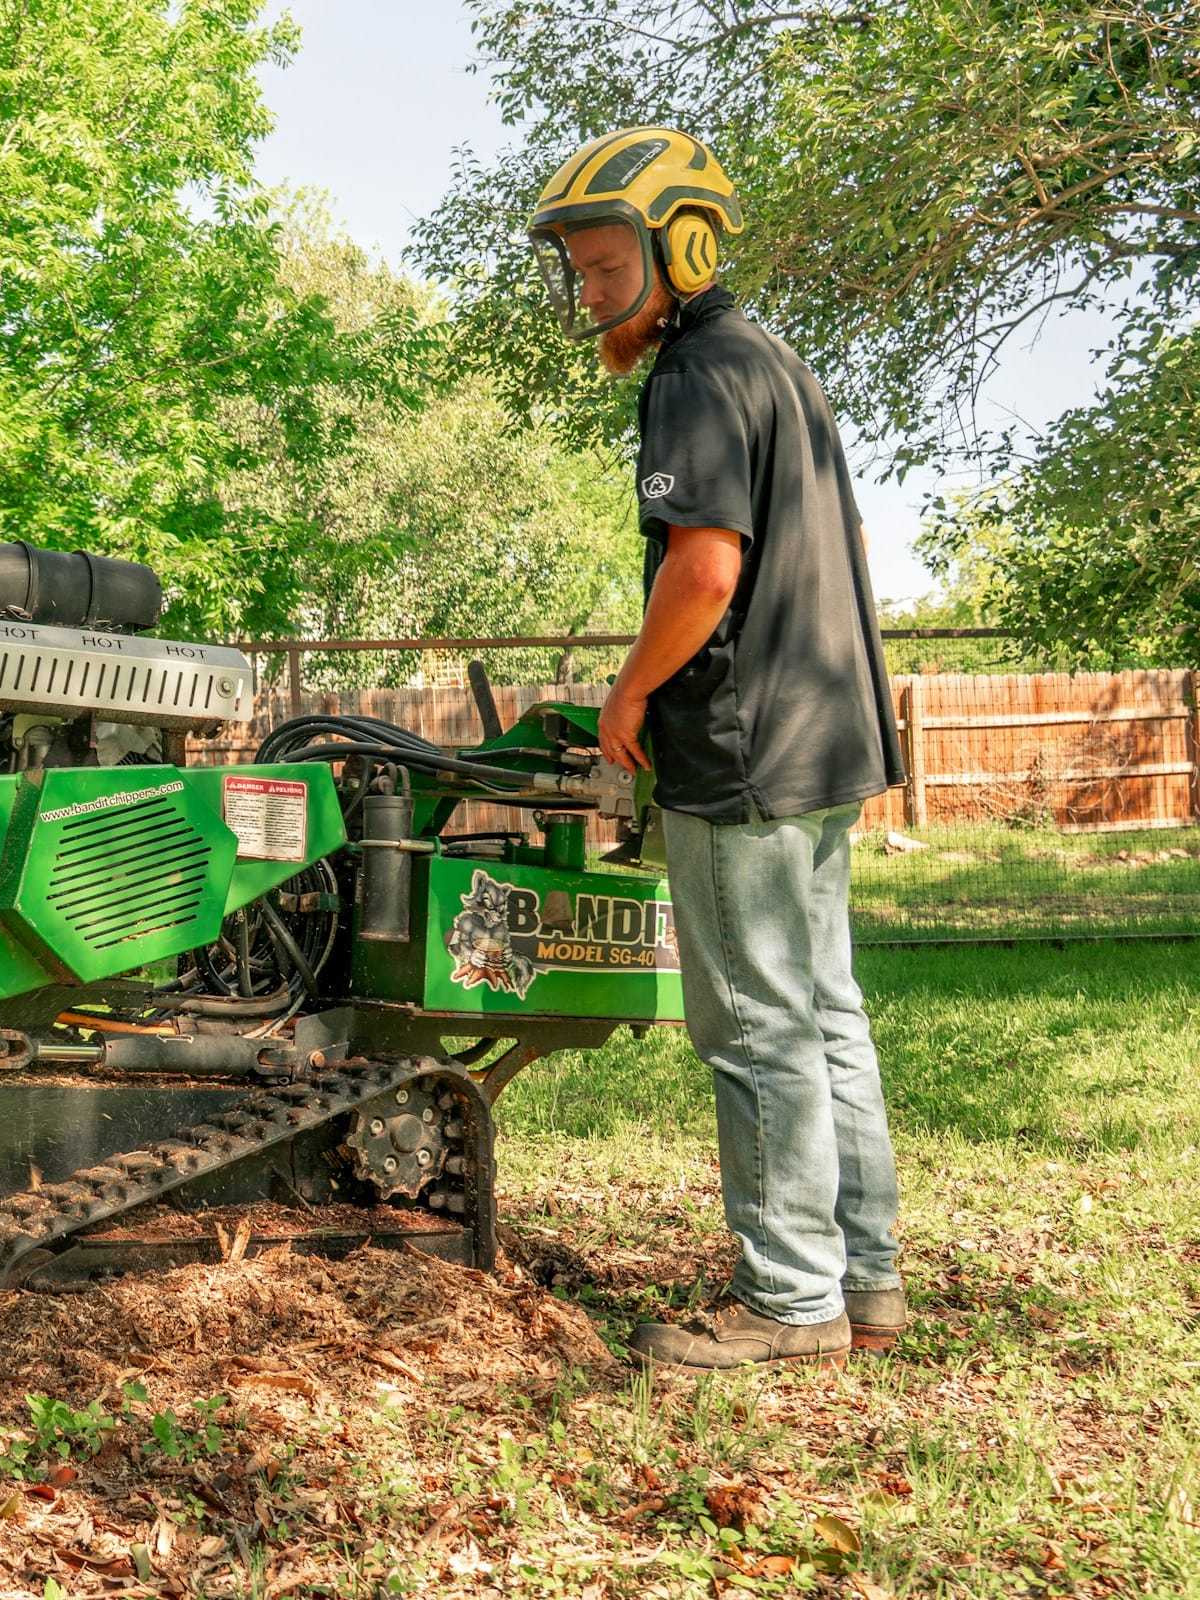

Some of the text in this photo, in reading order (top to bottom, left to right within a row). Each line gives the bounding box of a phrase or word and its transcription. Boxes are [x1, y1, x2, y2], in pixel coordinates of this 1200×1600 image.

[82, 635, 124, 650] HOT
[166, 645, 207, 660] HOT
[41, 781, 183, 822] www.banditchippers.com
[537, 941, 604, 963] MODEL
